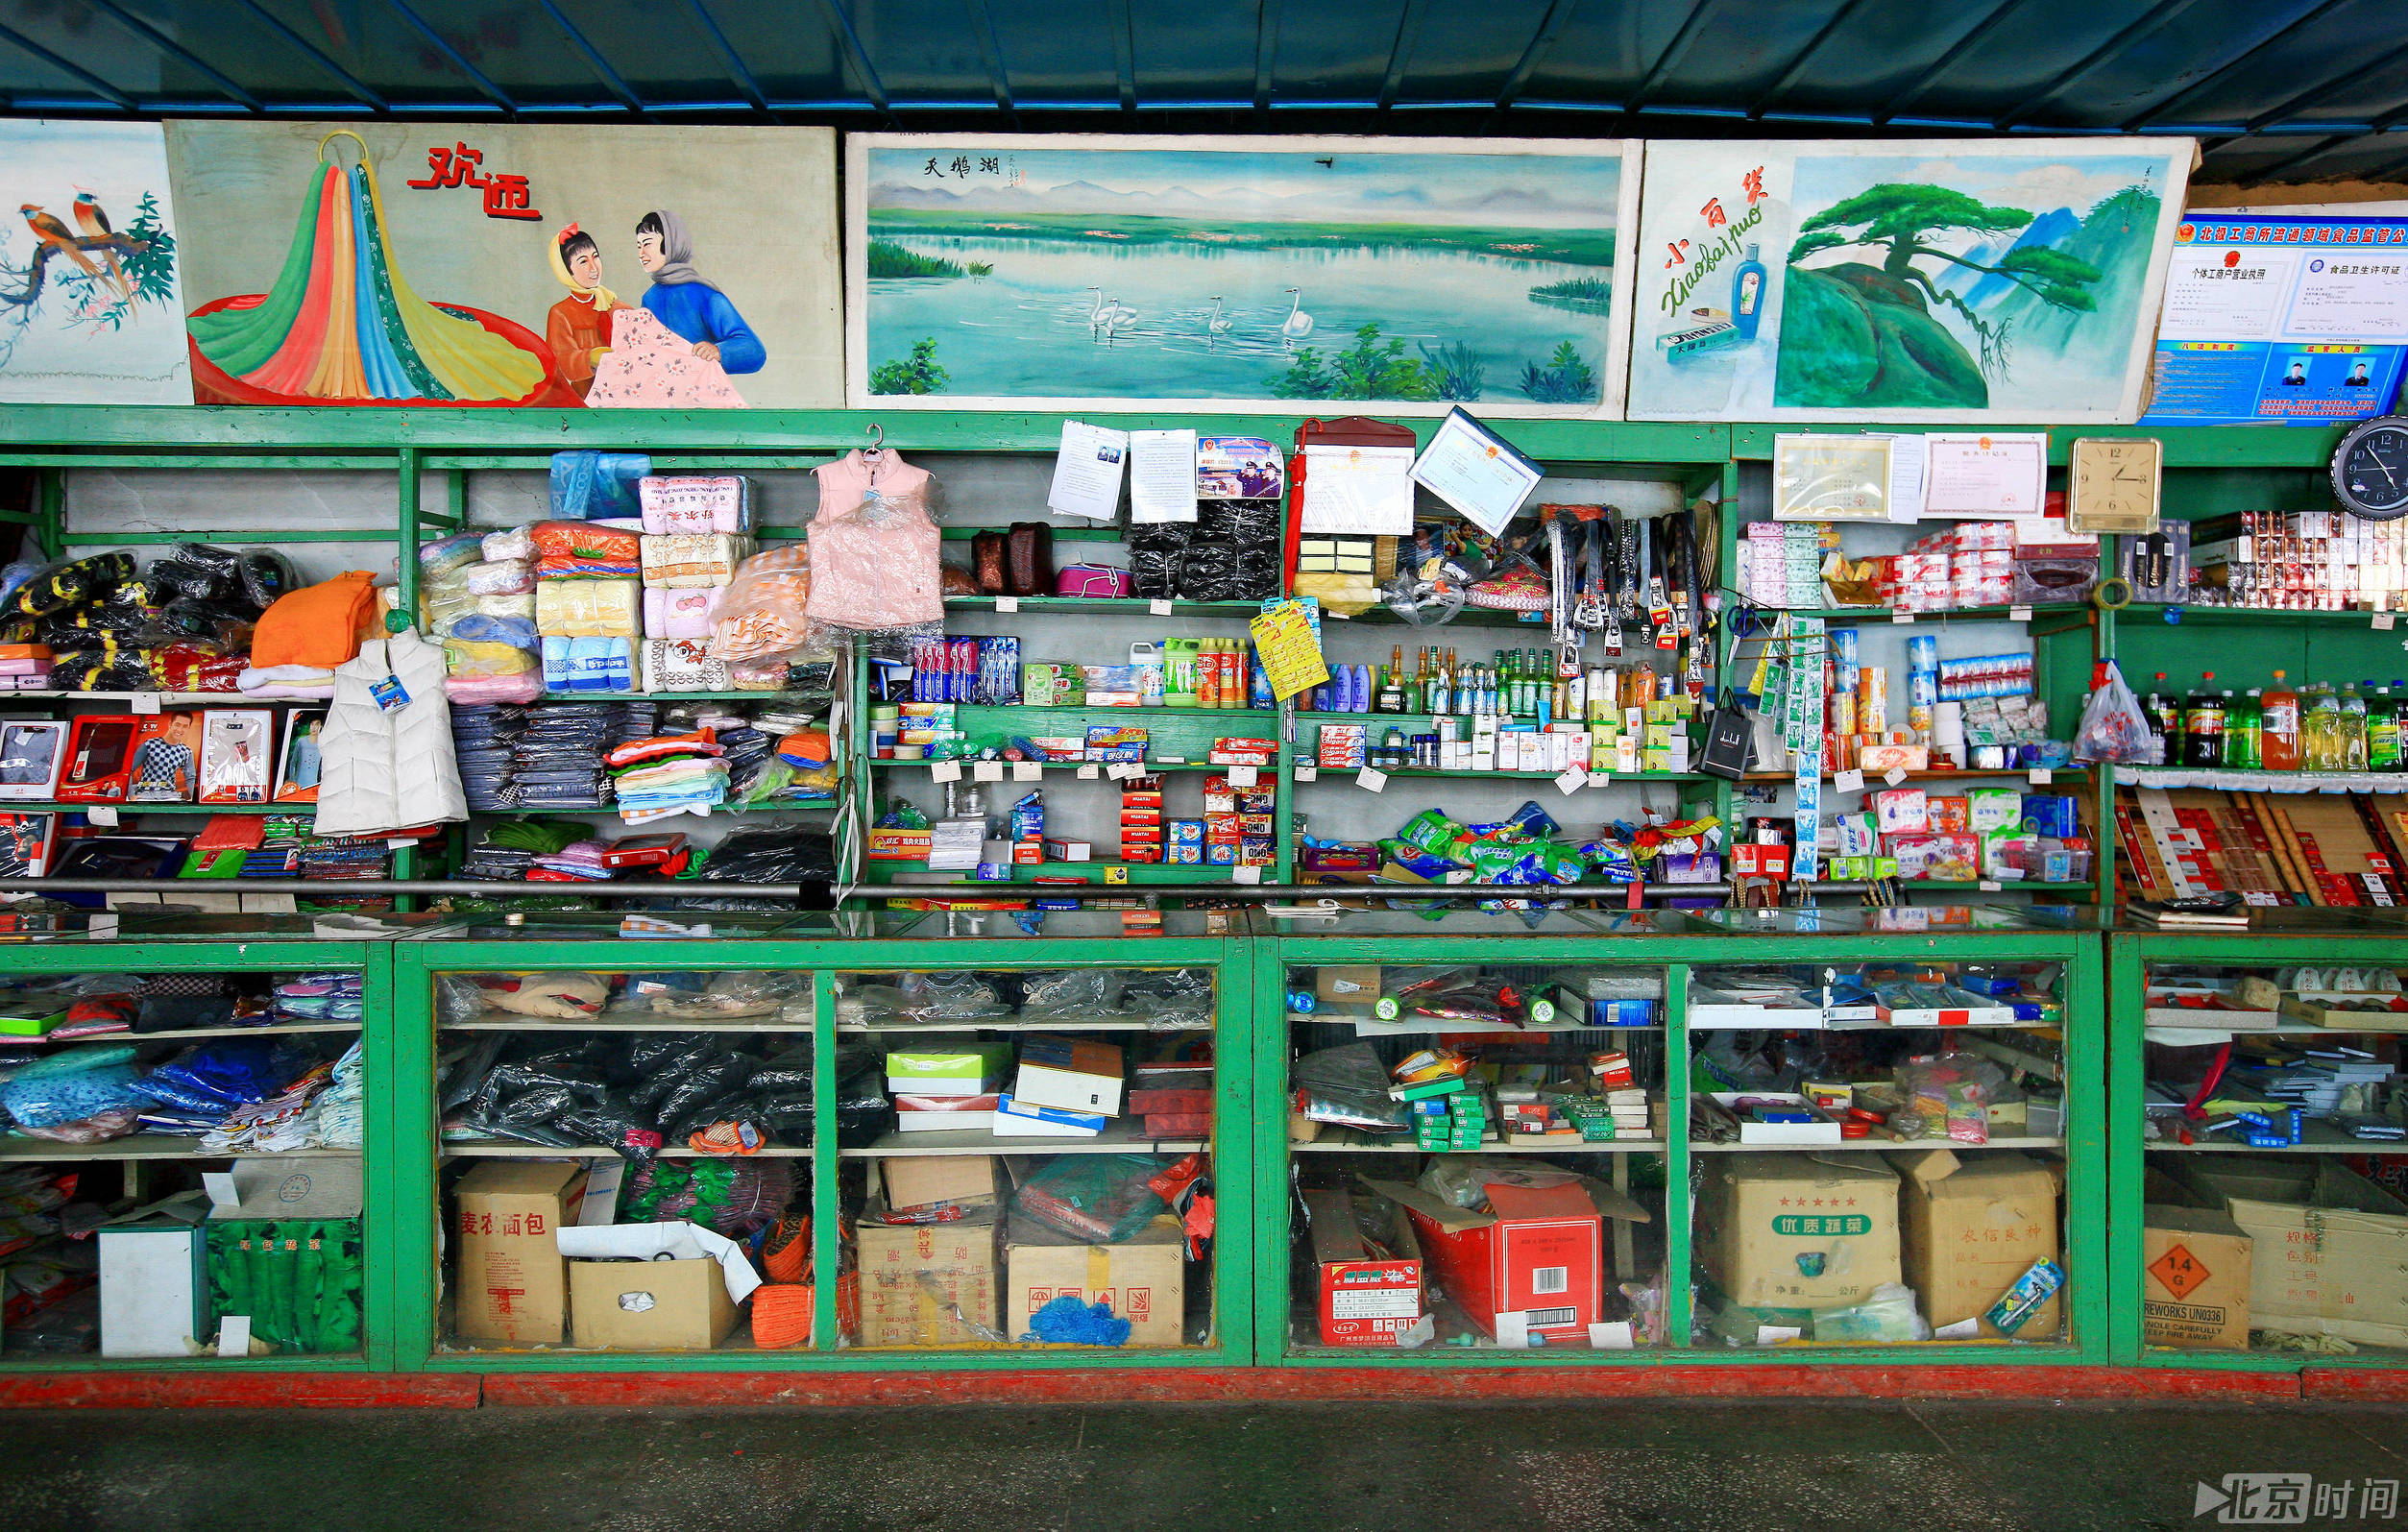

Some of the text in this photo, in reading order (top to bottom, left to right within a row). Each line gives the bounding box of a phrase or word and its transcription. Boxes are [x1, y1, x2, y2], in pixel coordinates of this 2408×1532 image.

[924, 157, 1000, 179] 天鹅湖
[1665, 166, 1768, 269] 小百货
[2200, 227, 2408, 243] 北极工商所流通领域食品监管公
[2329, 265, 2401, 275] 食品卫生许可证
[2368, 440, 2375, 449] 11
[2381, 435, 2392, 445] 12
[2110, 448, 2121, 458] 12
[2354, 450, 2365, 460] 10
[2348, 464, 2357, 474] 9
[2081, 474, 2089, 484] 9
[2376, 492, 2384, 501] 6
[2109, 500, 2116, 510] 6
[1782, 1217, 1862, 1233] 优质蔬菜
[2168, 1256, 2192, 1272] 1.4
[2174, 1276, 2184, 1286] G
[1838, 1285, 1860, 1296] 公斤
[2189, 1307, 2221, 1323] UN0336
